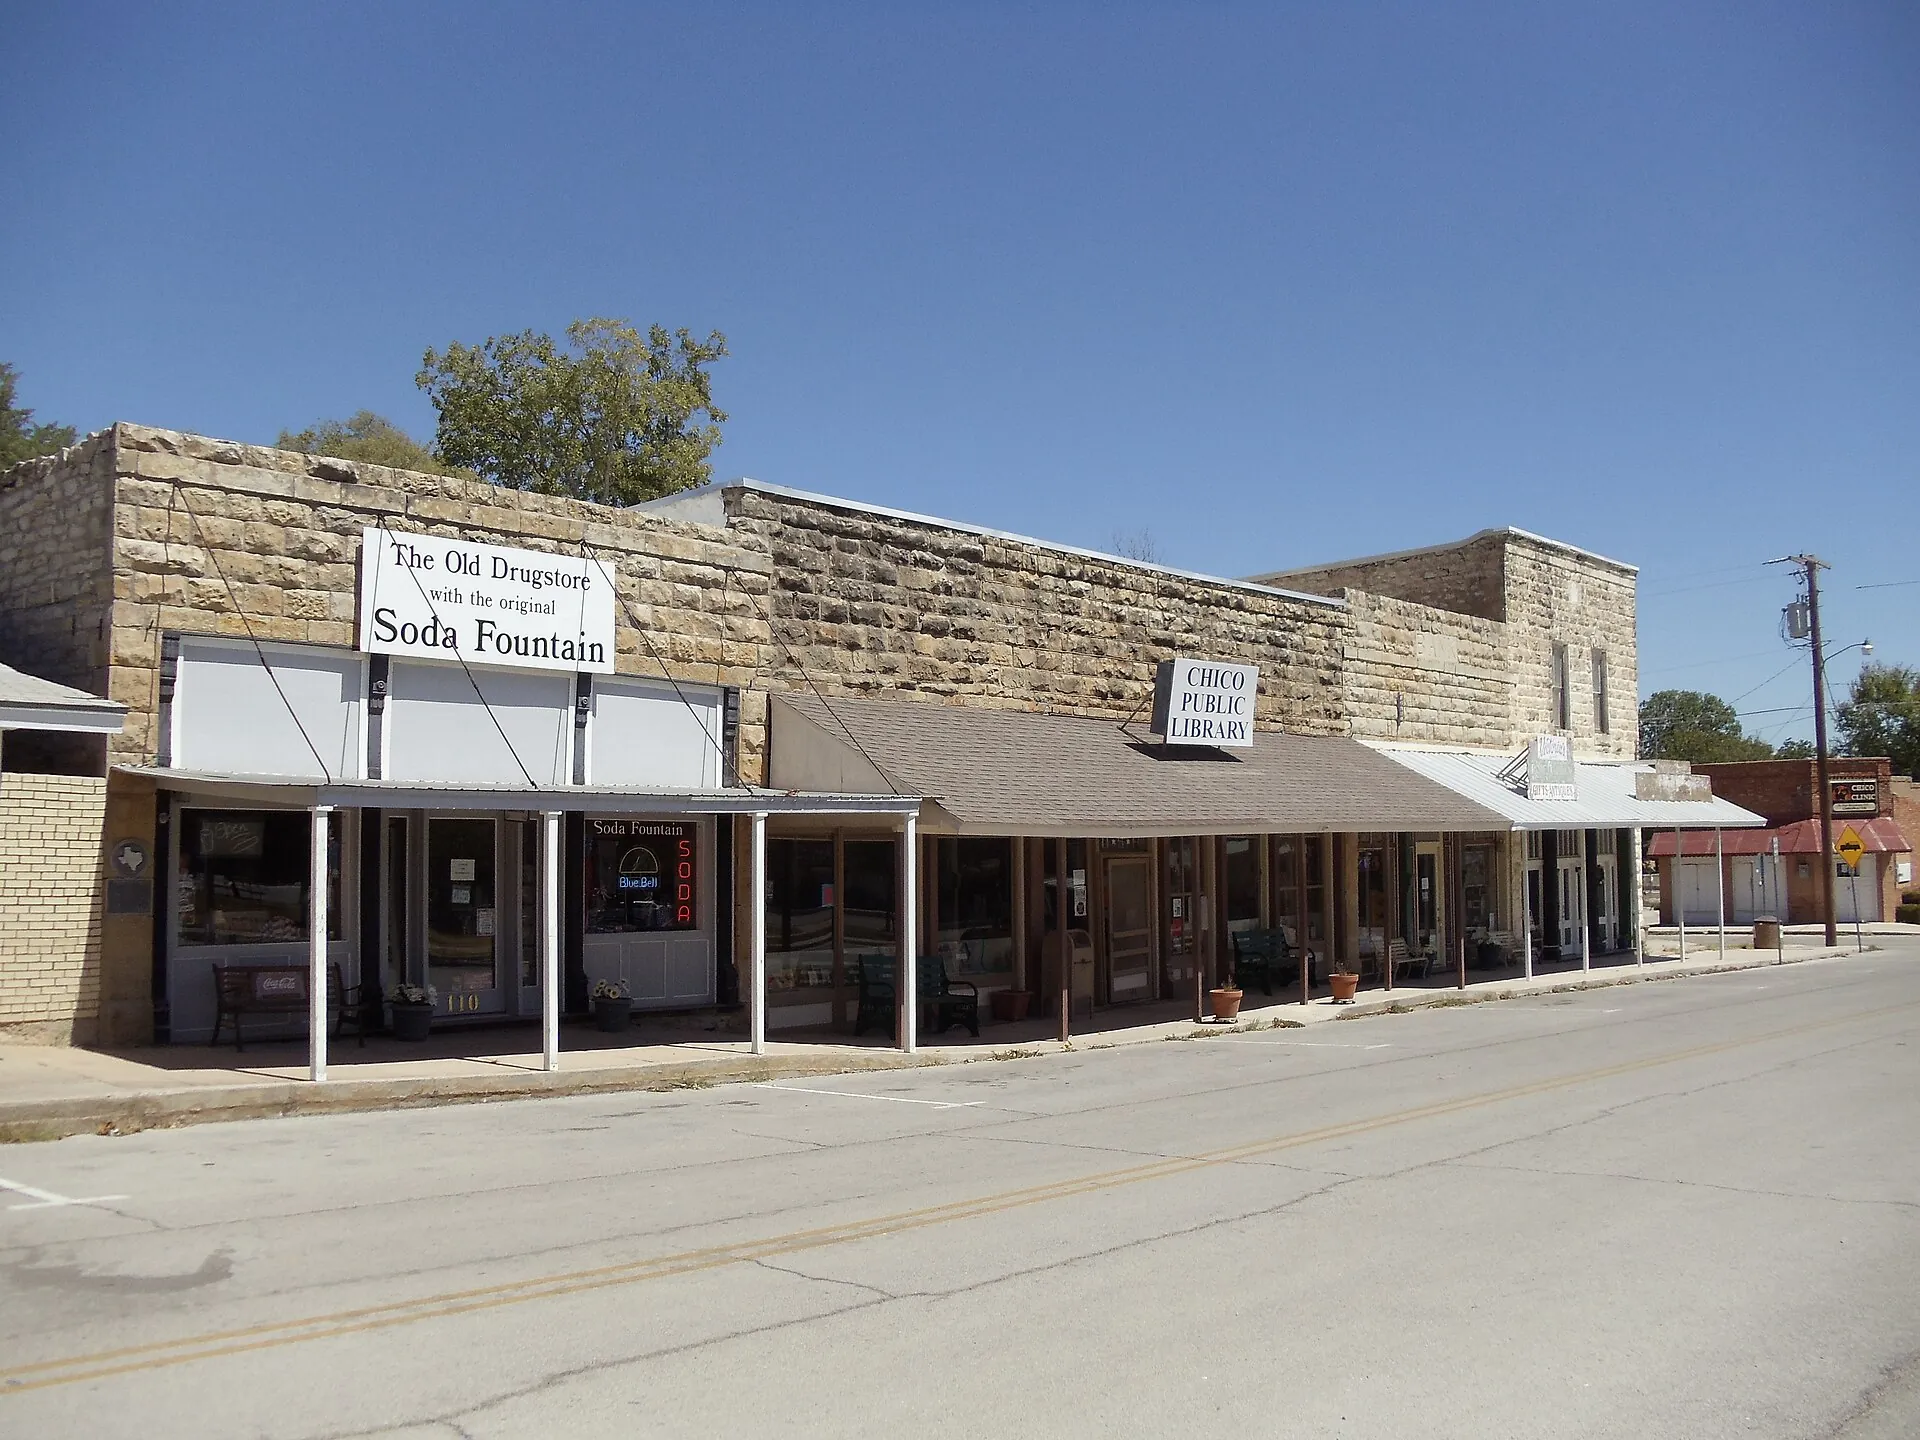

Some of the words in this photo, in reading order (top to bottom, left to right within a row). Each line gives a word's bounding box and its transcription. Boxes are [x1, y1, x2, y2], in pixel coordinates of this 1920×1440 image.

[390, 542, 435, 571] The
[445, 550, 481, 577] Old
[491, 556, 591, 592] Drugstore
[430, 586, 463, 604] with
[470, 591, 493, 608] the
[500, 595, 556, 616] original
[374, 607, 458, 650] Soda
[474, 619, 605, 664] Fountain
[1187, 666, 1245, 691] CHICO
[1181, 692, 1246, 716] PUBLIC
[1170, 717, 1249, 740] LIBRARY
[1851, 793, 1876, 801] CLINIC
[593, 820, 626, 835] Soda
[631, 821, 683, 836] Fountain
[619, 876, 639, 888] Blue
[640, 876, 658, 888] Bell
[677, 840, 691, 922] SODA
[448, 994, 480, 1012] 110
